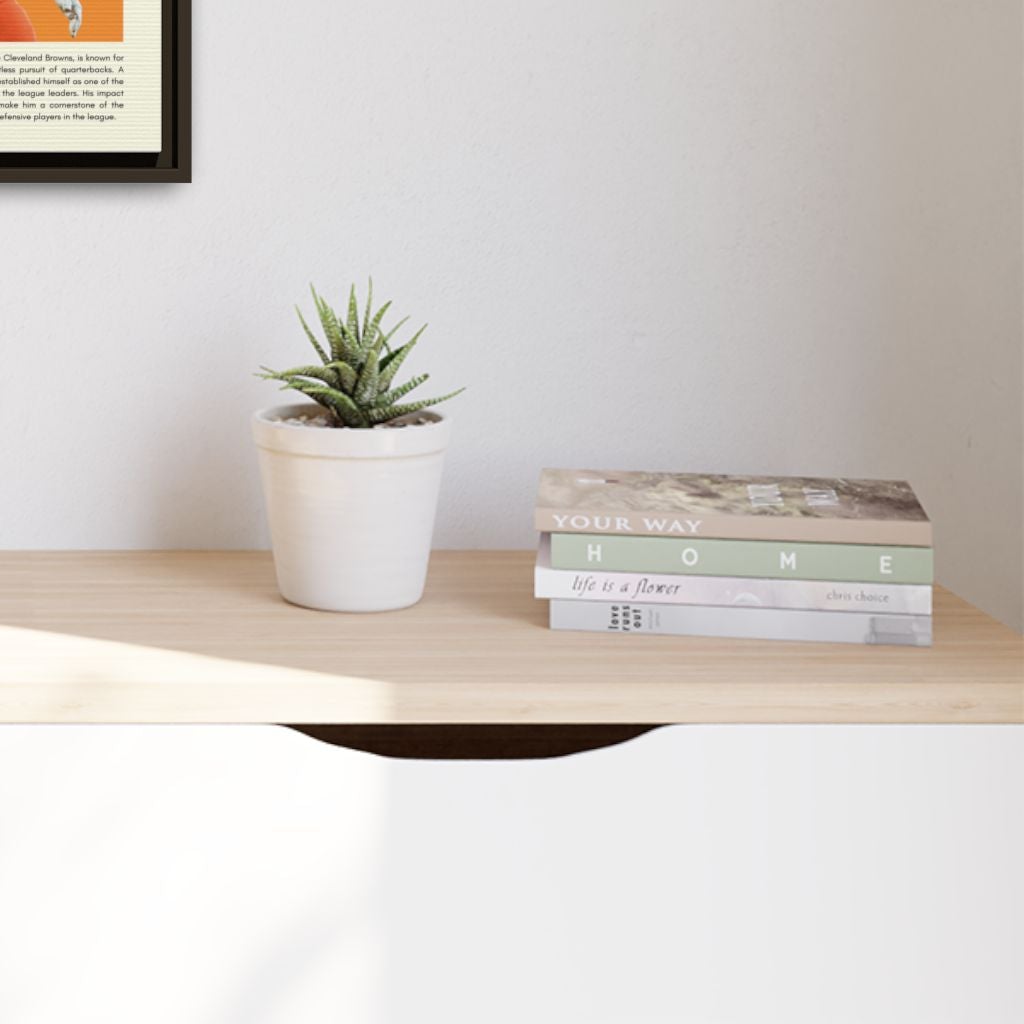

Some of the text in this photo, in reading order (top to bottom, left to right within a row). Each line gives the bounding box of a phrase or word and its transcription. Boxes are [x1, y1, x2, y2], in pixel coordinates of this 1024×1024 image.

[3, 54, 43, 62] Cleveland
[45, 54, 75, 63] Browns,
[86, 54, 111, 62] known
[113, 54, 124, 62] for
[19, 65, 45, 75] pursuit
[61, 65, 114, 75] quarterbacks.
[43, 77, 70, 85] himself
[112, 77, 124, 85] the
[2, 89, 15, 97] the
[18, 89, 45, 99] league
[48, 89, 79, 97] leaders.
[82, 89, 94, 97] His
[97, 89, 124, 99] impact
[22, 101, 36, 109] him
[49, 101, 95, 109] cornerstone
[111, 101, 124, 109] the
[33, 113, 61, 122] players
[87, 113, 116, 122] league.
[552, 514, 702, 533] YOUR WAY
[572, 576, 682, 599] life is a flower
[608, 605, 619, 630] love
[622, 605, 630, 631] runs
[632, 609, 642, 628] out
